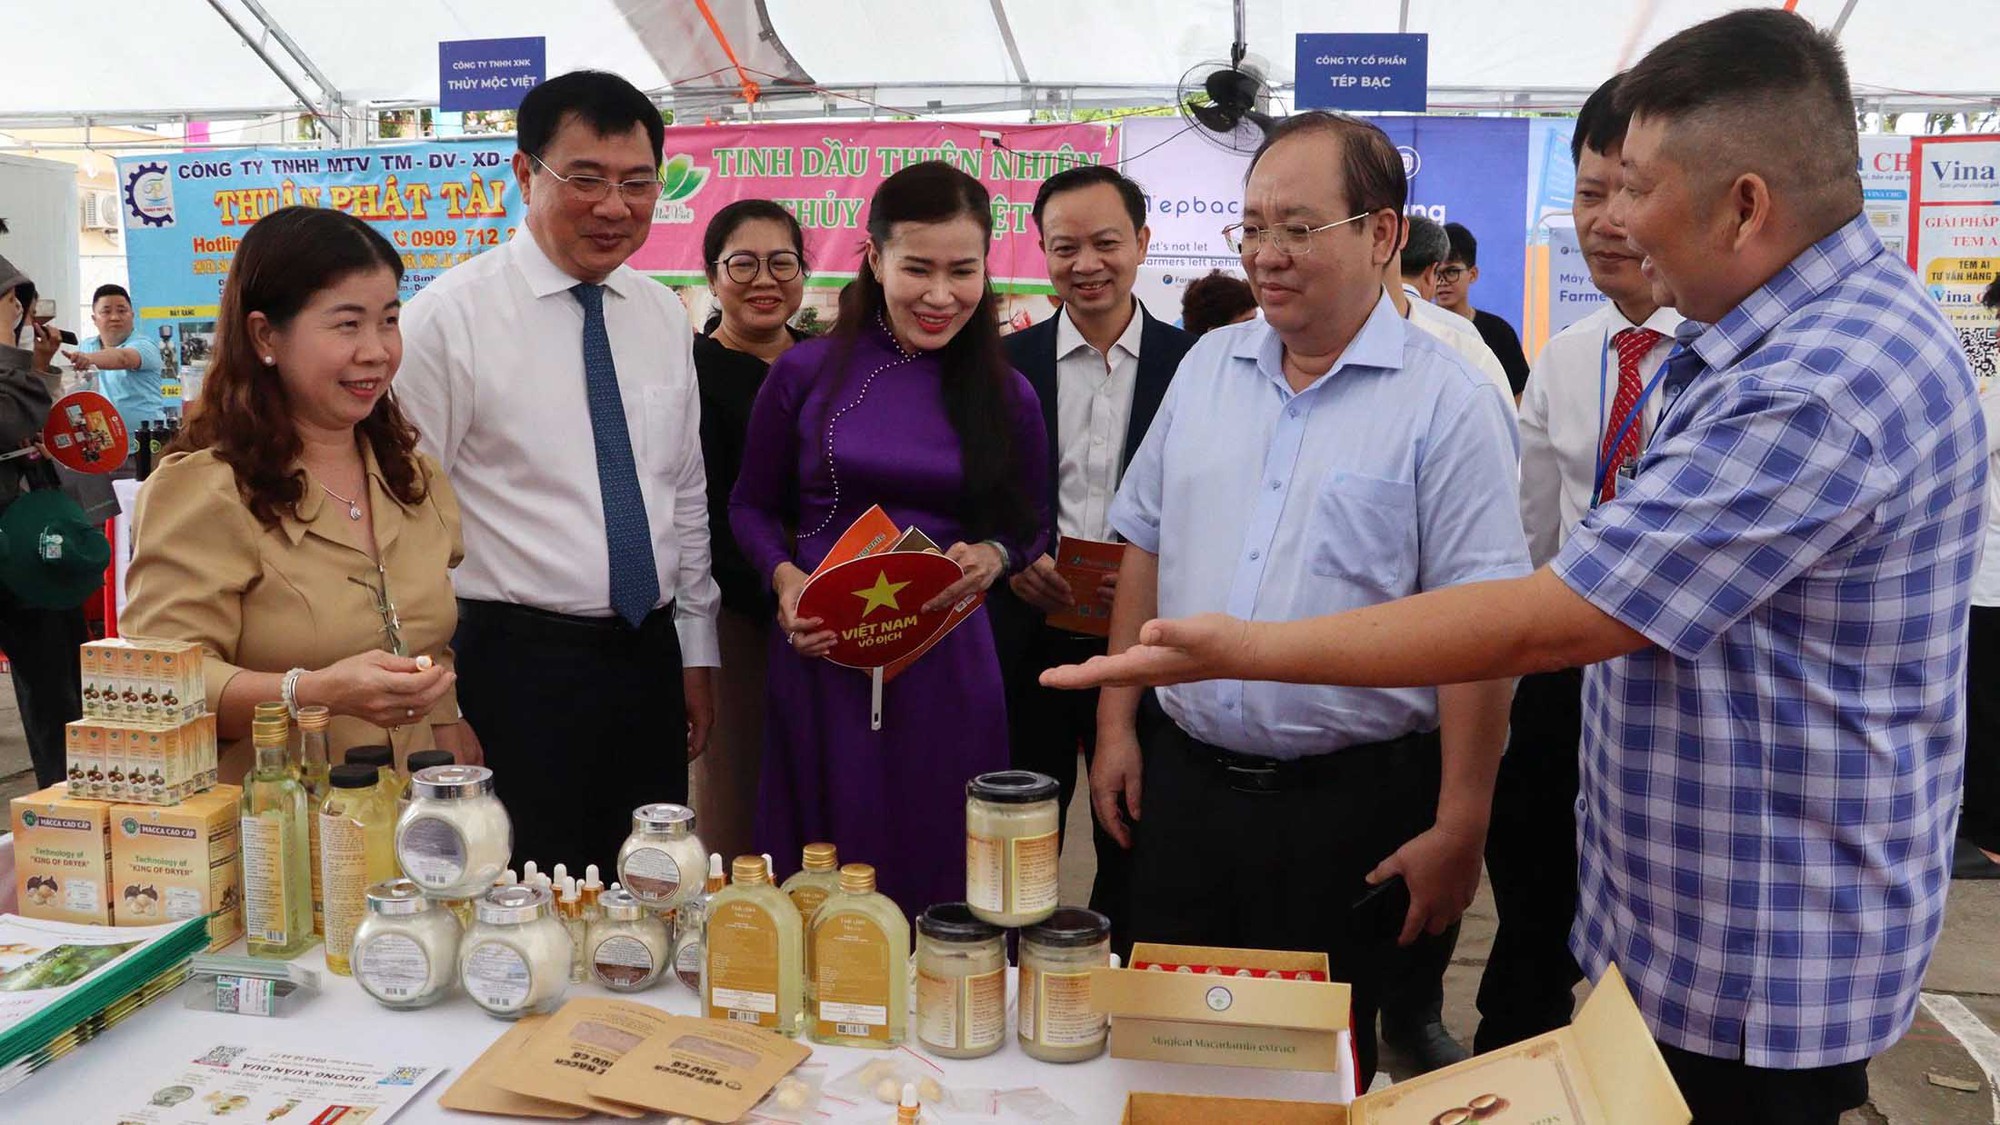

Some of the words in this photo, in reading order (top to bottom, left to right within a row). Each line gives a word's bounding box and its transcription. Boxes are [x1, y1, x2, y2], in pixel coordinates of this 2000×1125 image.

[453, 60, 476, 70] CÔNG
[478, 61, 487, 69] TY
[489, 60, 512, 68] TNHH
[513, 59, 531, 67] XNK
[1347, 57, 1358, 65] TY
[447, 76, 478, 90] THỦY
[481, 76, 508, 90] MỘC
[511, 74, 537, 90] VIỆT
[1330, 73, 1357, 87] TÉP
[1361, 76, 1391, 90] BẠC
[713, 147, 792, 177] TINH
[801, 138, 870, 177] DẦU
[1874, 152, 1911, 172] CH
[178, 161, 232, 179] CÔNG
[241, 161, 263, 175] TY
[271, 159, 319, 174] TNHH
[327, 157, 370, 172] MTV
[381, 155, 412, 169] TM
[1931, 161, 1995, 181] Vina
[440, 171, 507, 219] TÀI
[991, 194, 1032, 239] ỆT
[411, 230, 457, 247] 0909
[465, 228, 499, 245] 712
[1953, 236, 1984, 246] TEM
[1149, 241, 1168, 251] et's
[1172, 243, 1190, 251] not
[1194, 241, 1208, 251] let
[1189, 258, 1206, 266] left
[1959, 260, 1978, 269] TEM
[1981, 260, 1990, 269] AI
[1560, 290, 1606, 302] Farme
[1934, 290, 1971, 302] Vina
[841, 622, 878, 641] VIỆT
[880, 614, 918, 633] NAM
[858, 636, 874, 648] VÔ
[876, 631, 902, 645] ĐỊCH
[40, 818, 62, 827] MACCA
[63, 820, 76, 828] CAO
[142, 825, 165, 834] MACCA
[35, 847, 74, 858] Technology
[77, 850, 84, 858] of
[135, 855, 178, 867] Technology
[179, 859, 187, 867] of
[1151, 1036, 1193, 1047] Magical
[1195, 1038, 1256, 1051] Macadamia
[1258, 1044, 1296, 1053] extract
